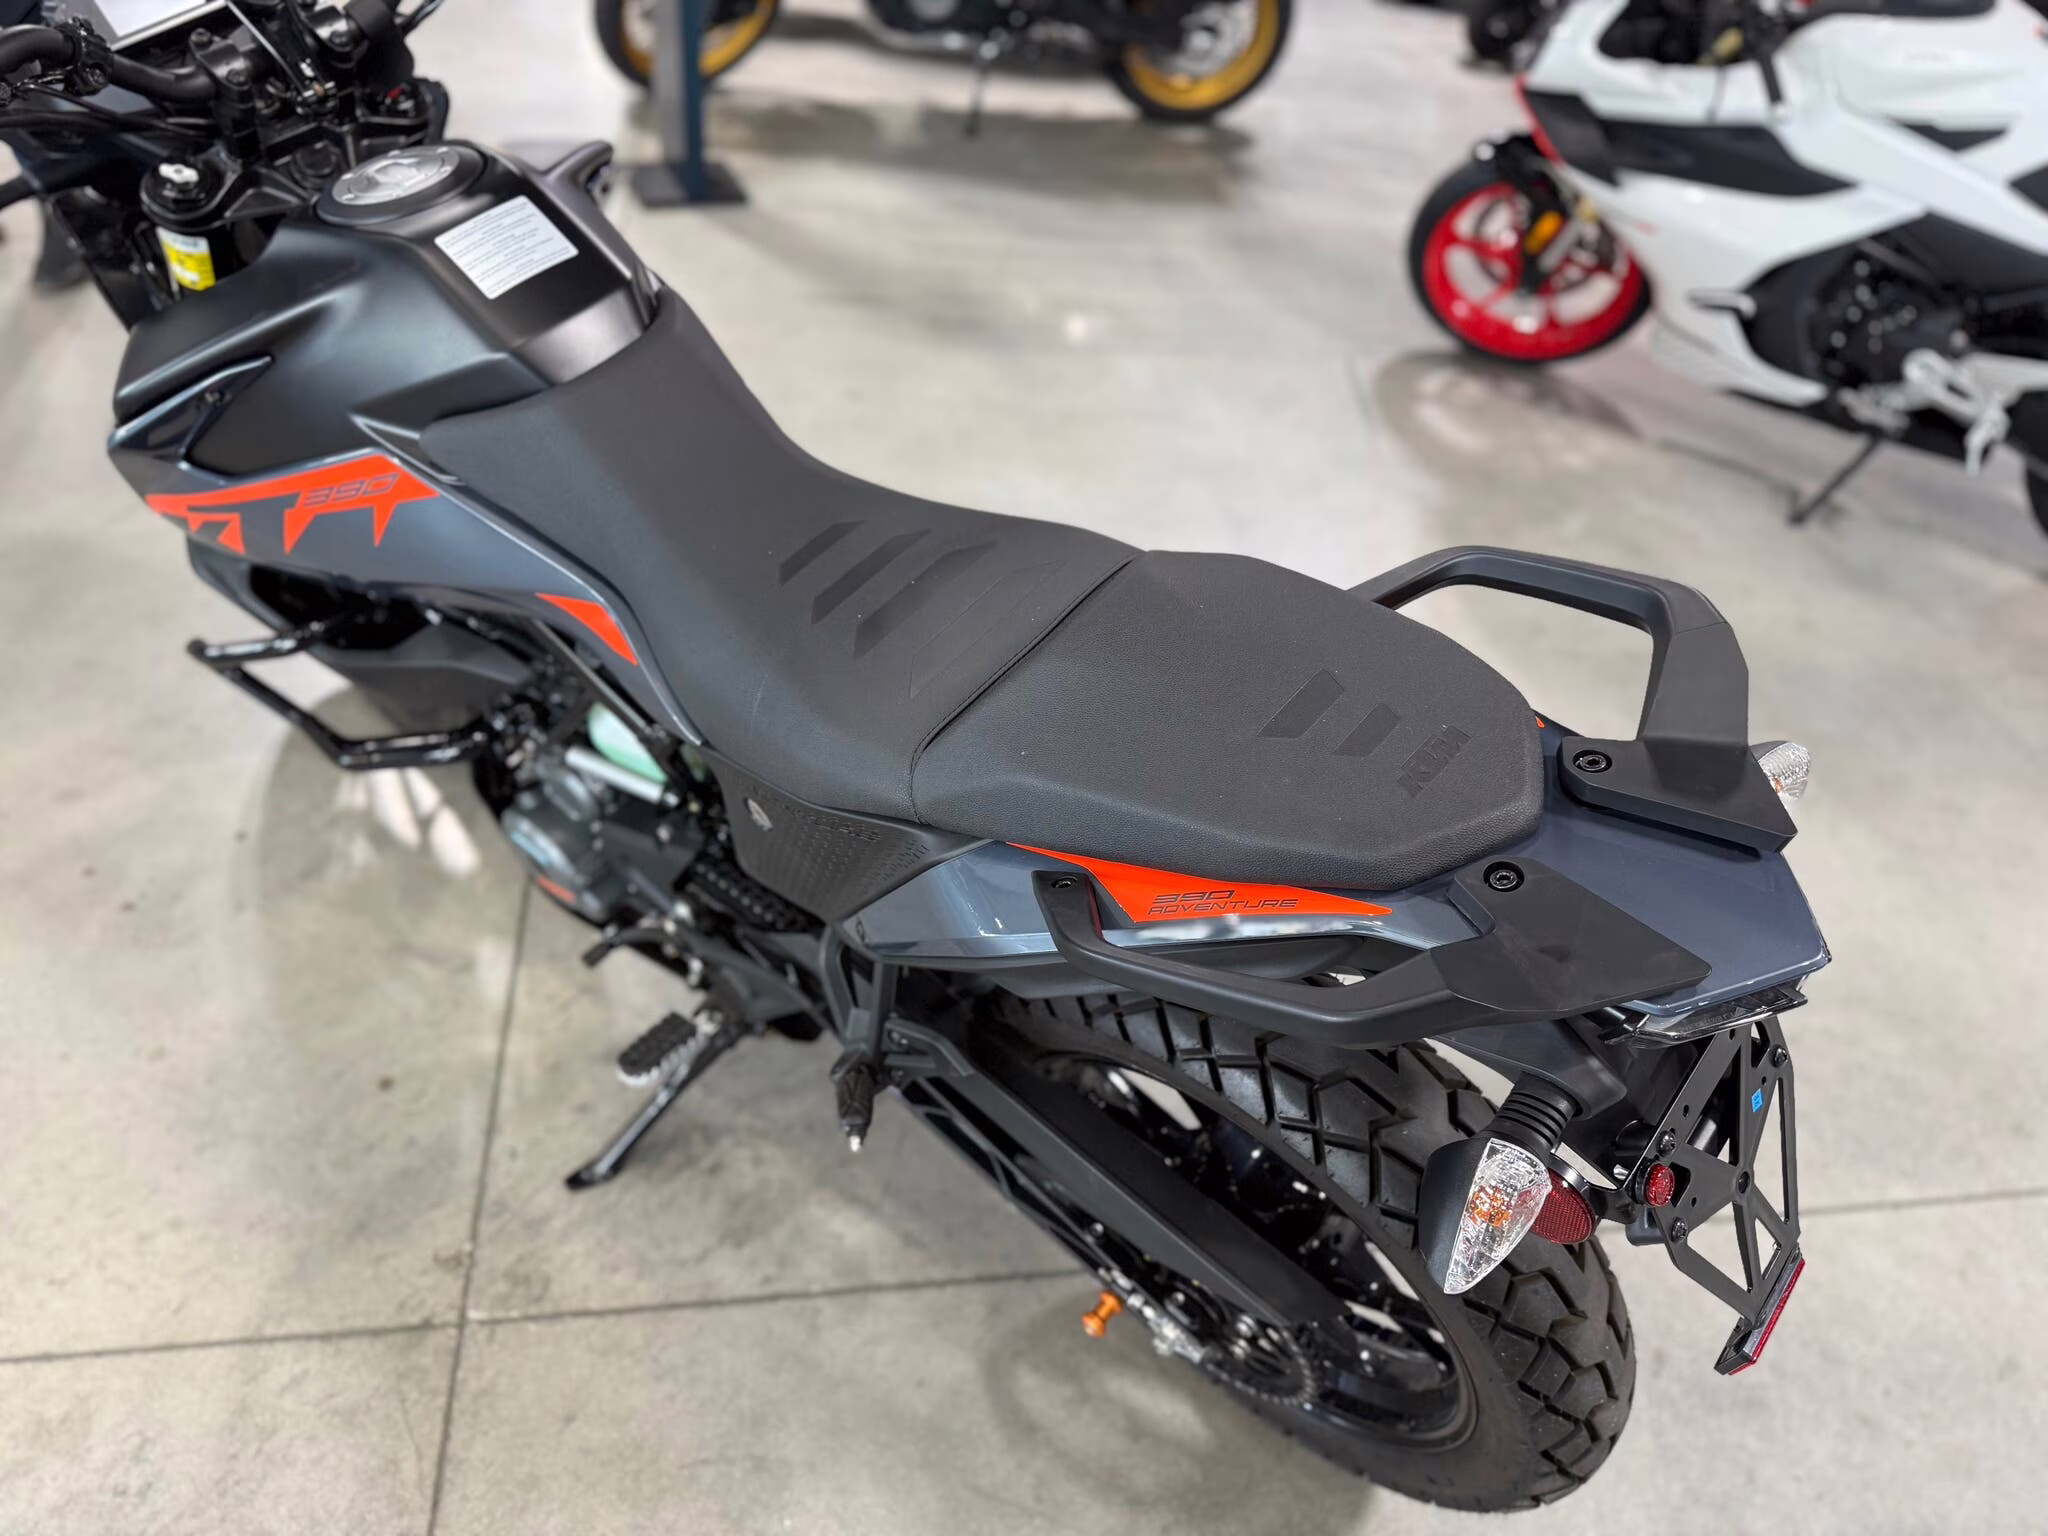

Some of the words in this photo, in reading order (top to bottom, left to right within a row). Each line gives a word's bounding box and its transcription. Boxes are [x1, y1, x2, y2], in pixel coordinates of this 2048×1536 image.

[304, 473, 400, 506] 390
[1397, 726, 1473, 797] KTM
[1148, 899, 1298, 914] ADVENTURE
[1153, 890, 1235, 903] 390
